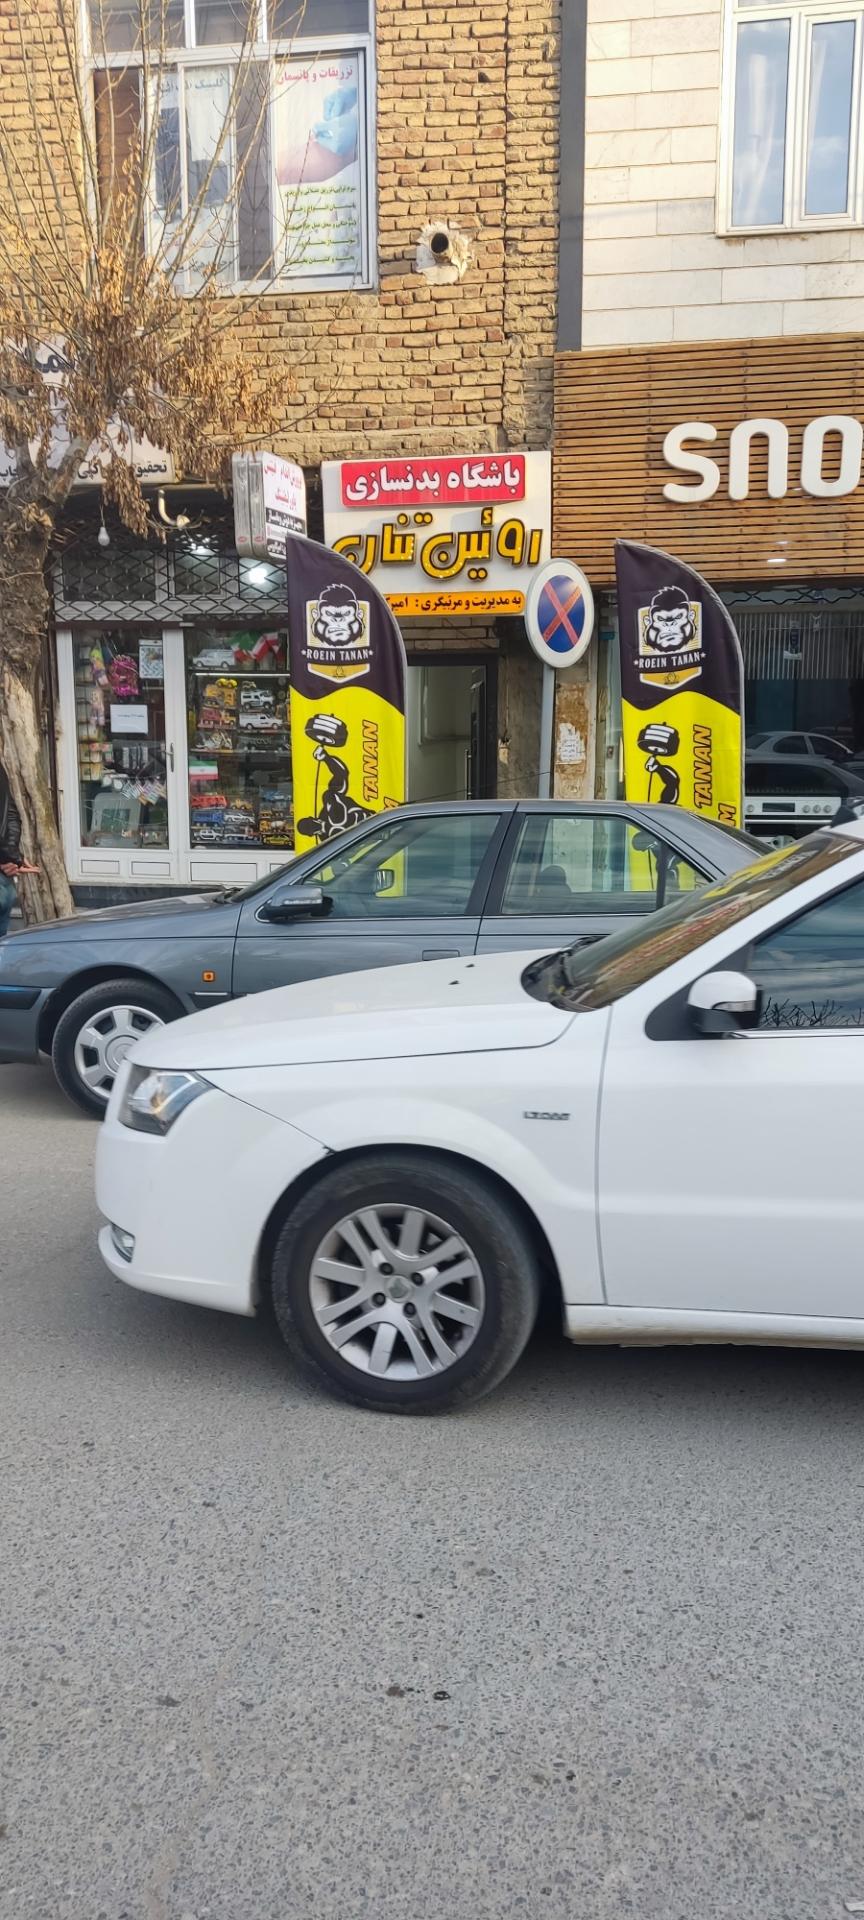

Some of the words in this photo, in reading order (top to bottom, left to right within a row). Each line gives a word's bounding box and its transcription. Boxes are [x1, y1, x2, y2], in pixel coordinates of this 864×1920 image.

[346, 463, 441, 501] بدنسازی
[447, 460, 521, 494] باشگاه
[464, 599, 470, 611] و
[472, 595, 510, 610] مدیریت
[511, 596, 522, 609] به
[306, 648, 336, 661] ROEIN
[340, 648, 369, 661] TANAN
[638, 657, 667, 669] ROEIN
[671, 651, 701, 667] TANAN
[362, 719, 379, 802] TANAN
[693, 724, 713, 809] TANAN
